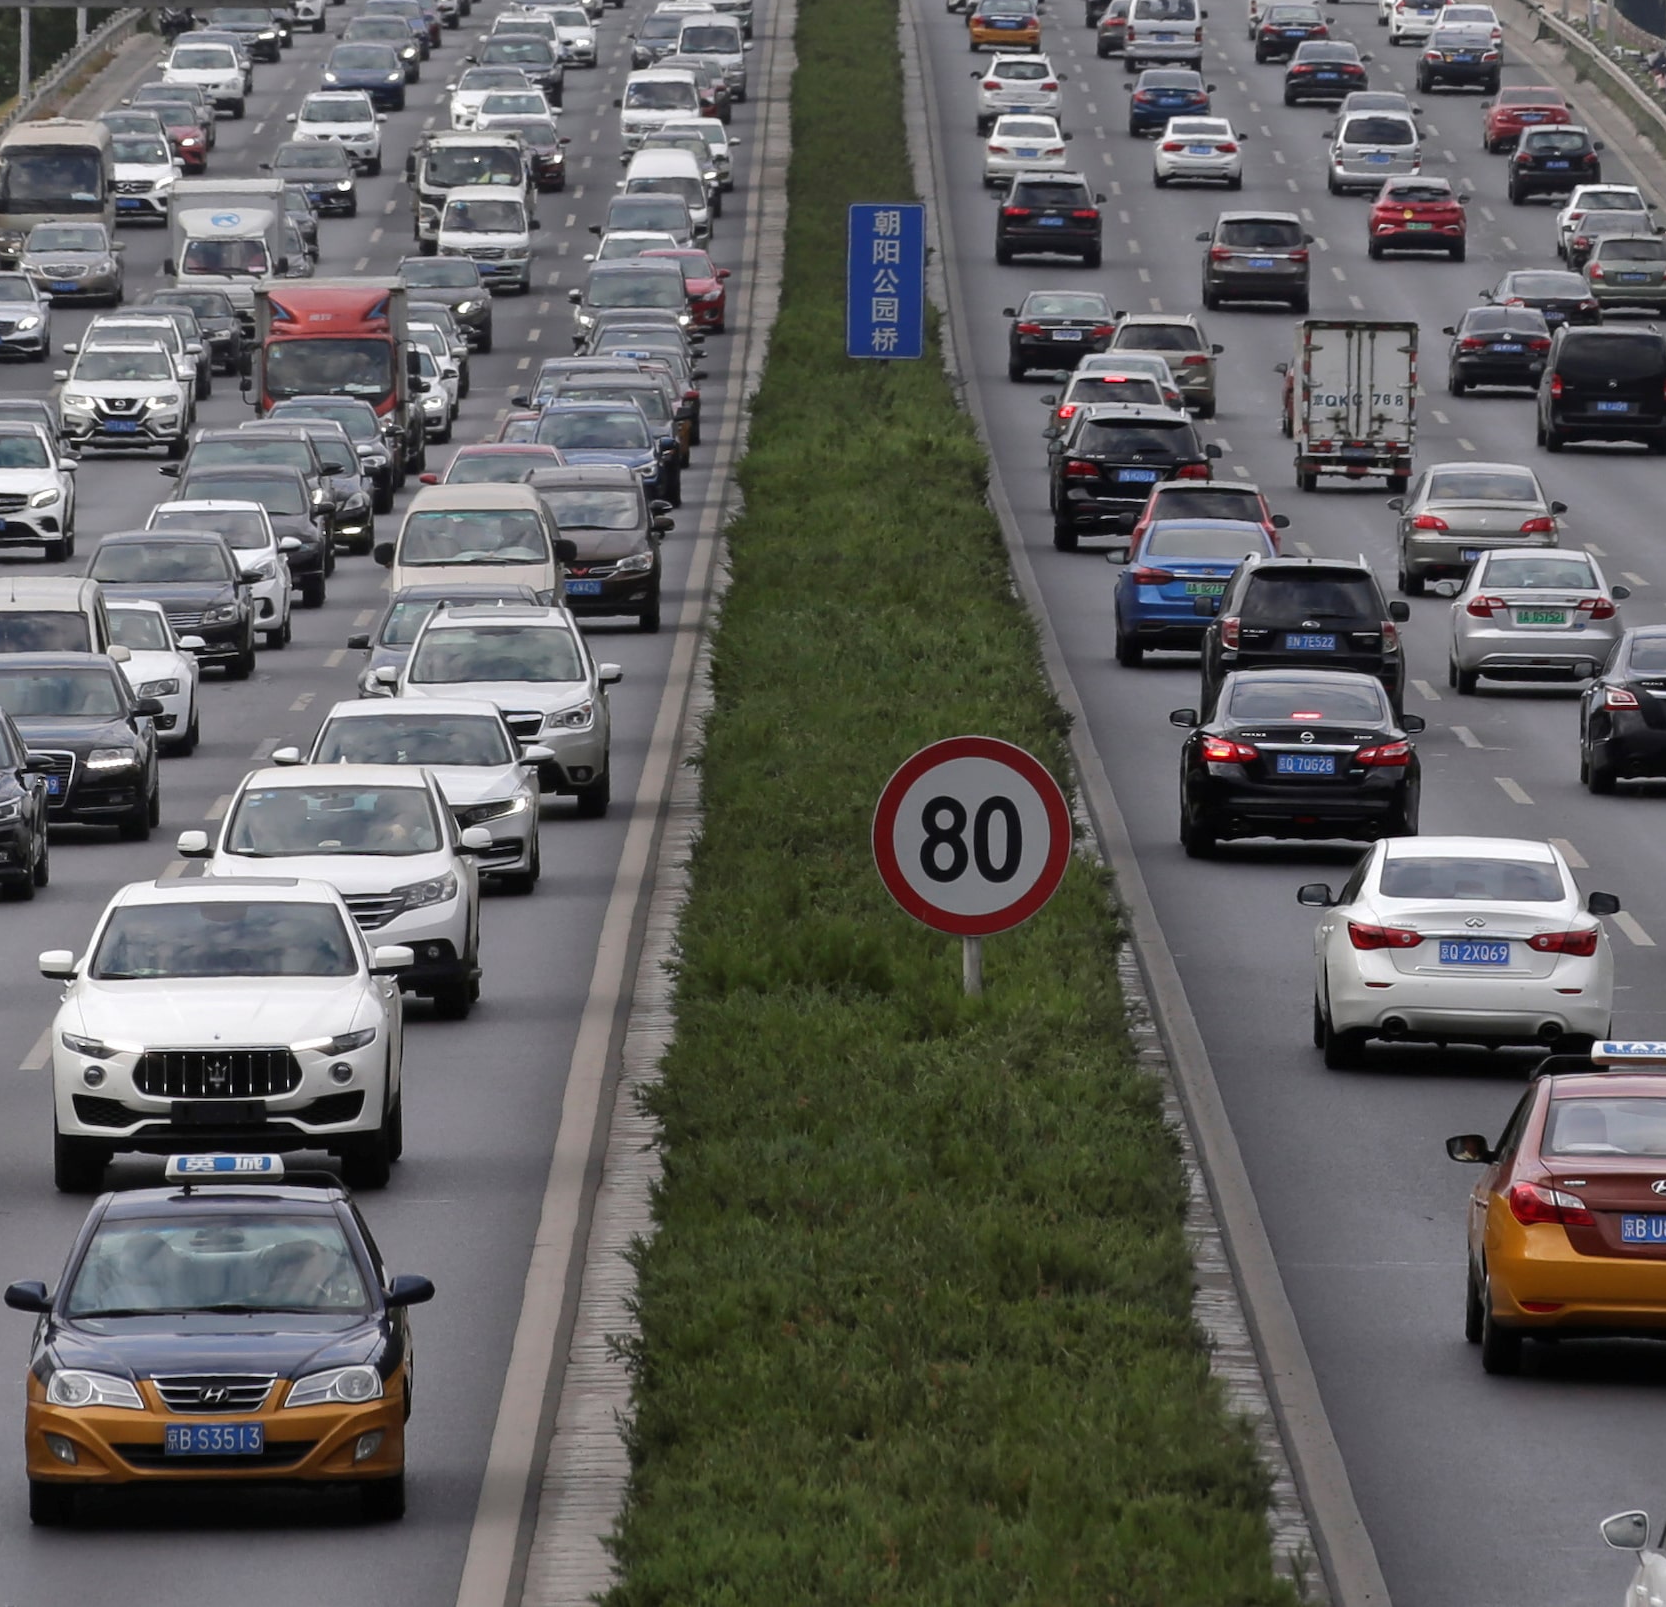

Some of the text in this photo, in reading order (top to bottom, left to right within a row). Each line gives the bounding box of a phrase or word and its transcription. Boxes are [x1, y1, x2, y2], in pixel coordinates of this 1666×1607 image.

[870, 209, 902, 353] 朝阳公园桥
